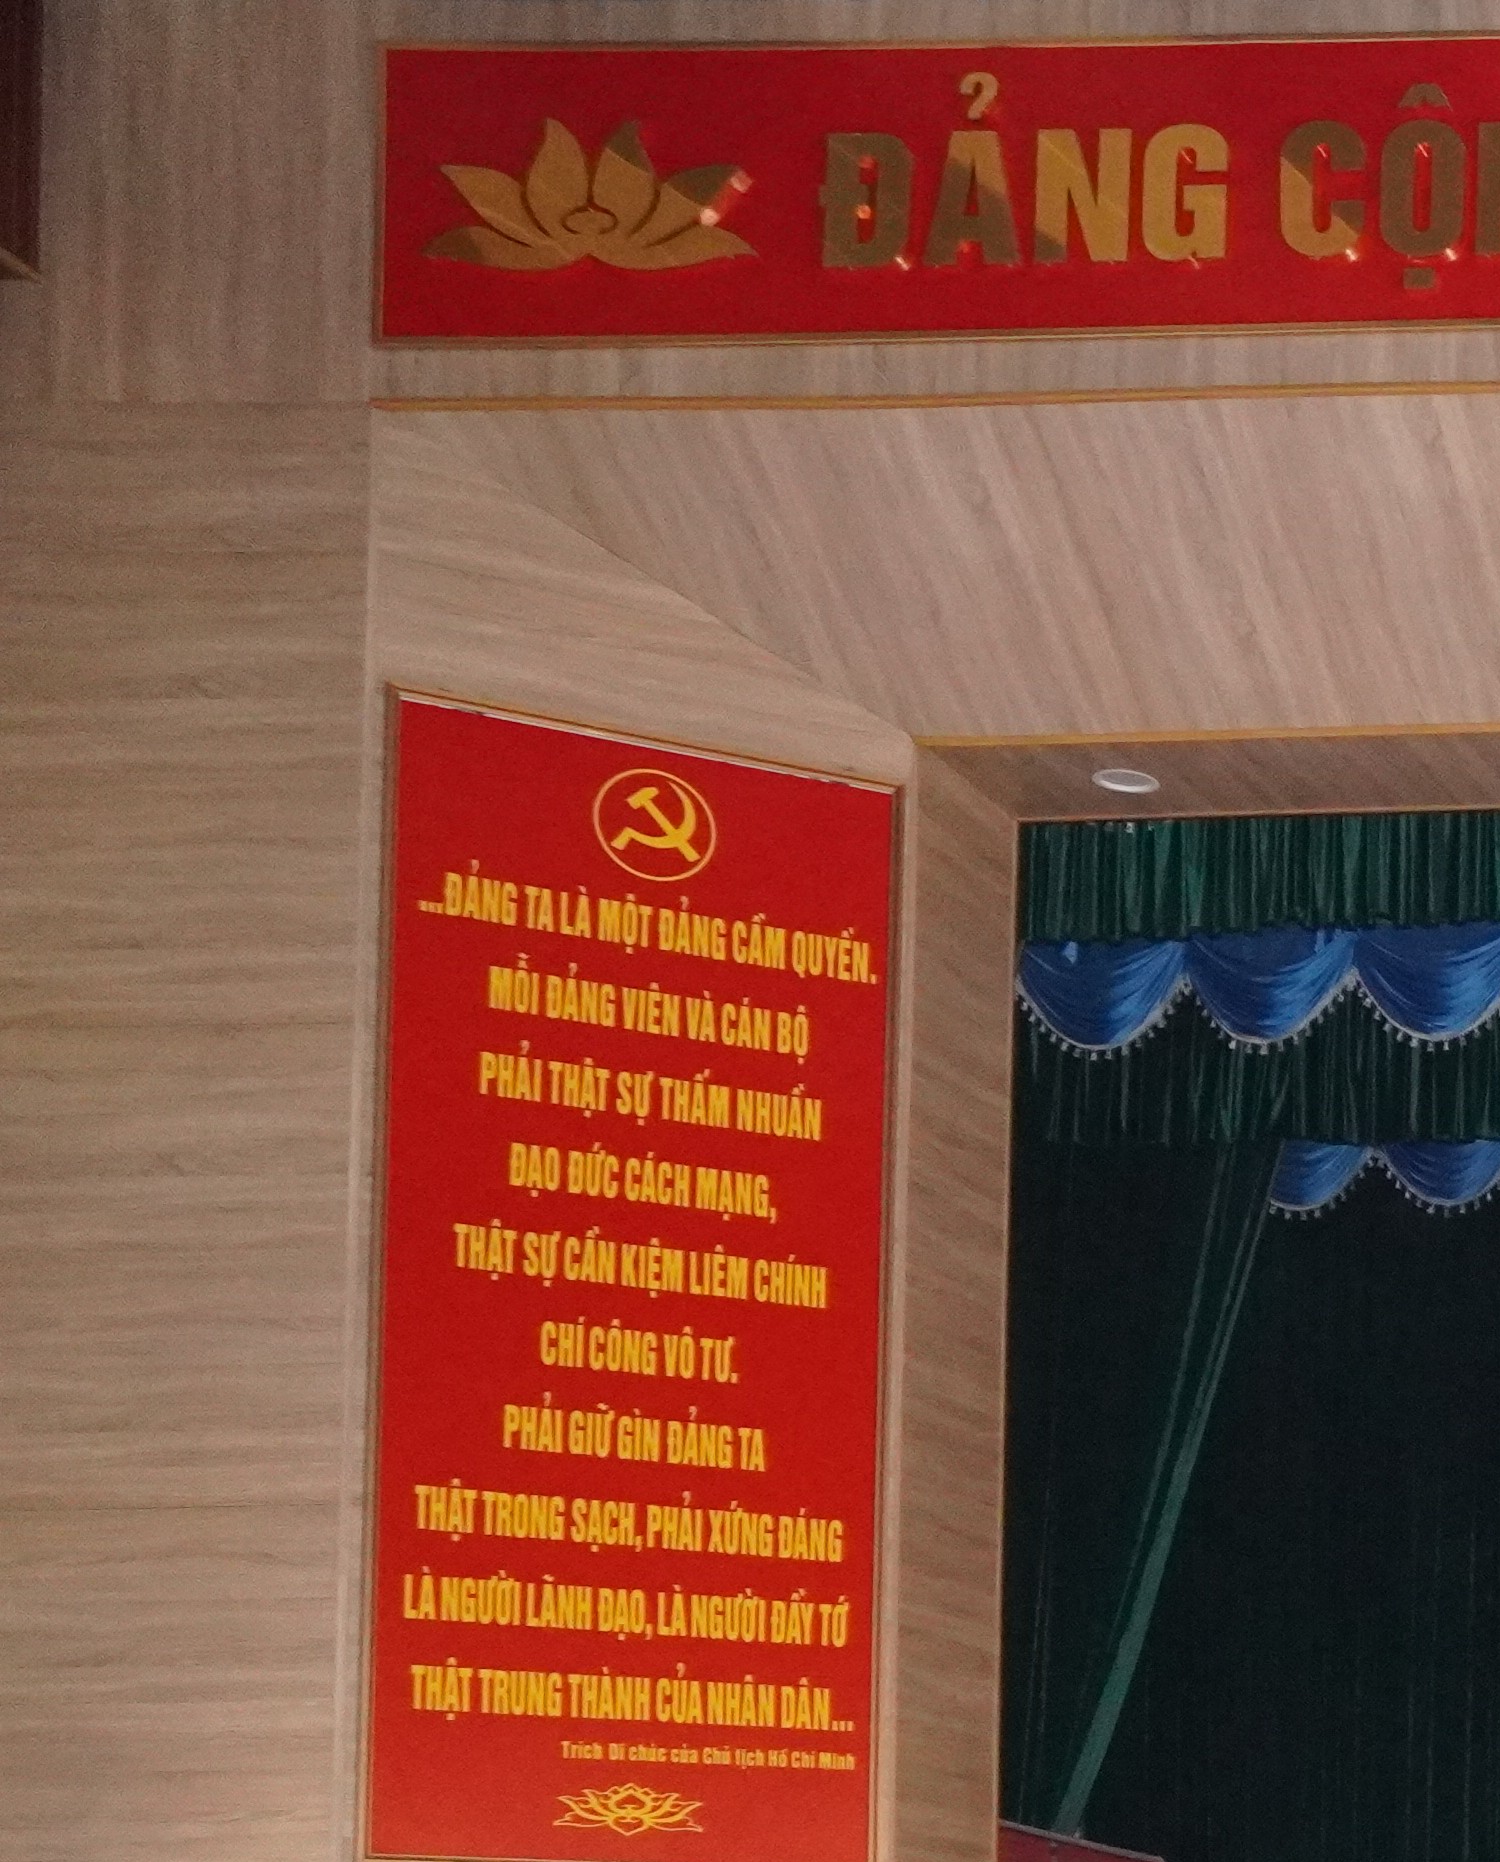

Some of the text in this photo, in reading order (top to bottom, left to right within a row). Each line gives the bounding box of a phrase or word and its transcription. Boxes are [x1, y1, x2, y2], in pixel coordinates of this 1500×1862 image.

[819, 71, 1230, 267] ĐẢNG
[525, 886, 554, 932] TA
[560, 886, 591, 938] LÀ
[598, 894, 652, 954] MỘT
[658, 896, 726, 960] ĐẢNG
[732, 913, 786, 969] CẦM
[792, 927, 877, 984] QUYỀN.
[546, 963, 615, 1027] ĐẢNG
[622, 983, 680, 1037] VIÊN
[686, 991, 716, 1042] VÀ
[721, 998, 771, 1051] CÁN
[777, 1005, 809, 1064] BỘ
[480, 1040, 822, 1141] PHẢI THẬT SỰ THẤM NHUẦN
[509, 1142, 776, 1223] ĐẠO ĐỨC CÁCH MẠNG,
[454, 1219, 827, 1308] THẬT SỰ CẦN KIỆM LIÊM CHÍNH
[541, 1317, 737, 1383] CHÍ CÔNG VÔ TƯ.
[503, 1392, 765, 1471] PHẢI GIỮ GÌN ĐẢNG TA
[415, 1478, 843, 1562] THẬT TRONG SẠCH, PHẢI XỨNG ĐÁNG
[404, 1566, 437, 1620] LÀ
[440, 1570, 522, 1625] NGƯỜI
[526, 1574, 593, 1630] LÃNH
[597, 1588, 653, 1640] ĐẠO,
[657, 1585, 688, 1636] LÀ
[690, 1588, 767, 1642] NGƯỜI
[819, 1596, 850, 1647] TỚ
[411, 1657, 474, 1720] THẬT
[478, 1669, 563, 1717] TRUNG
[567, 1667, 651, 1721] THÀNH
[655, 1663, 703, 1724] CỦA
[707, 1675, 776, 1727] NHÂN
